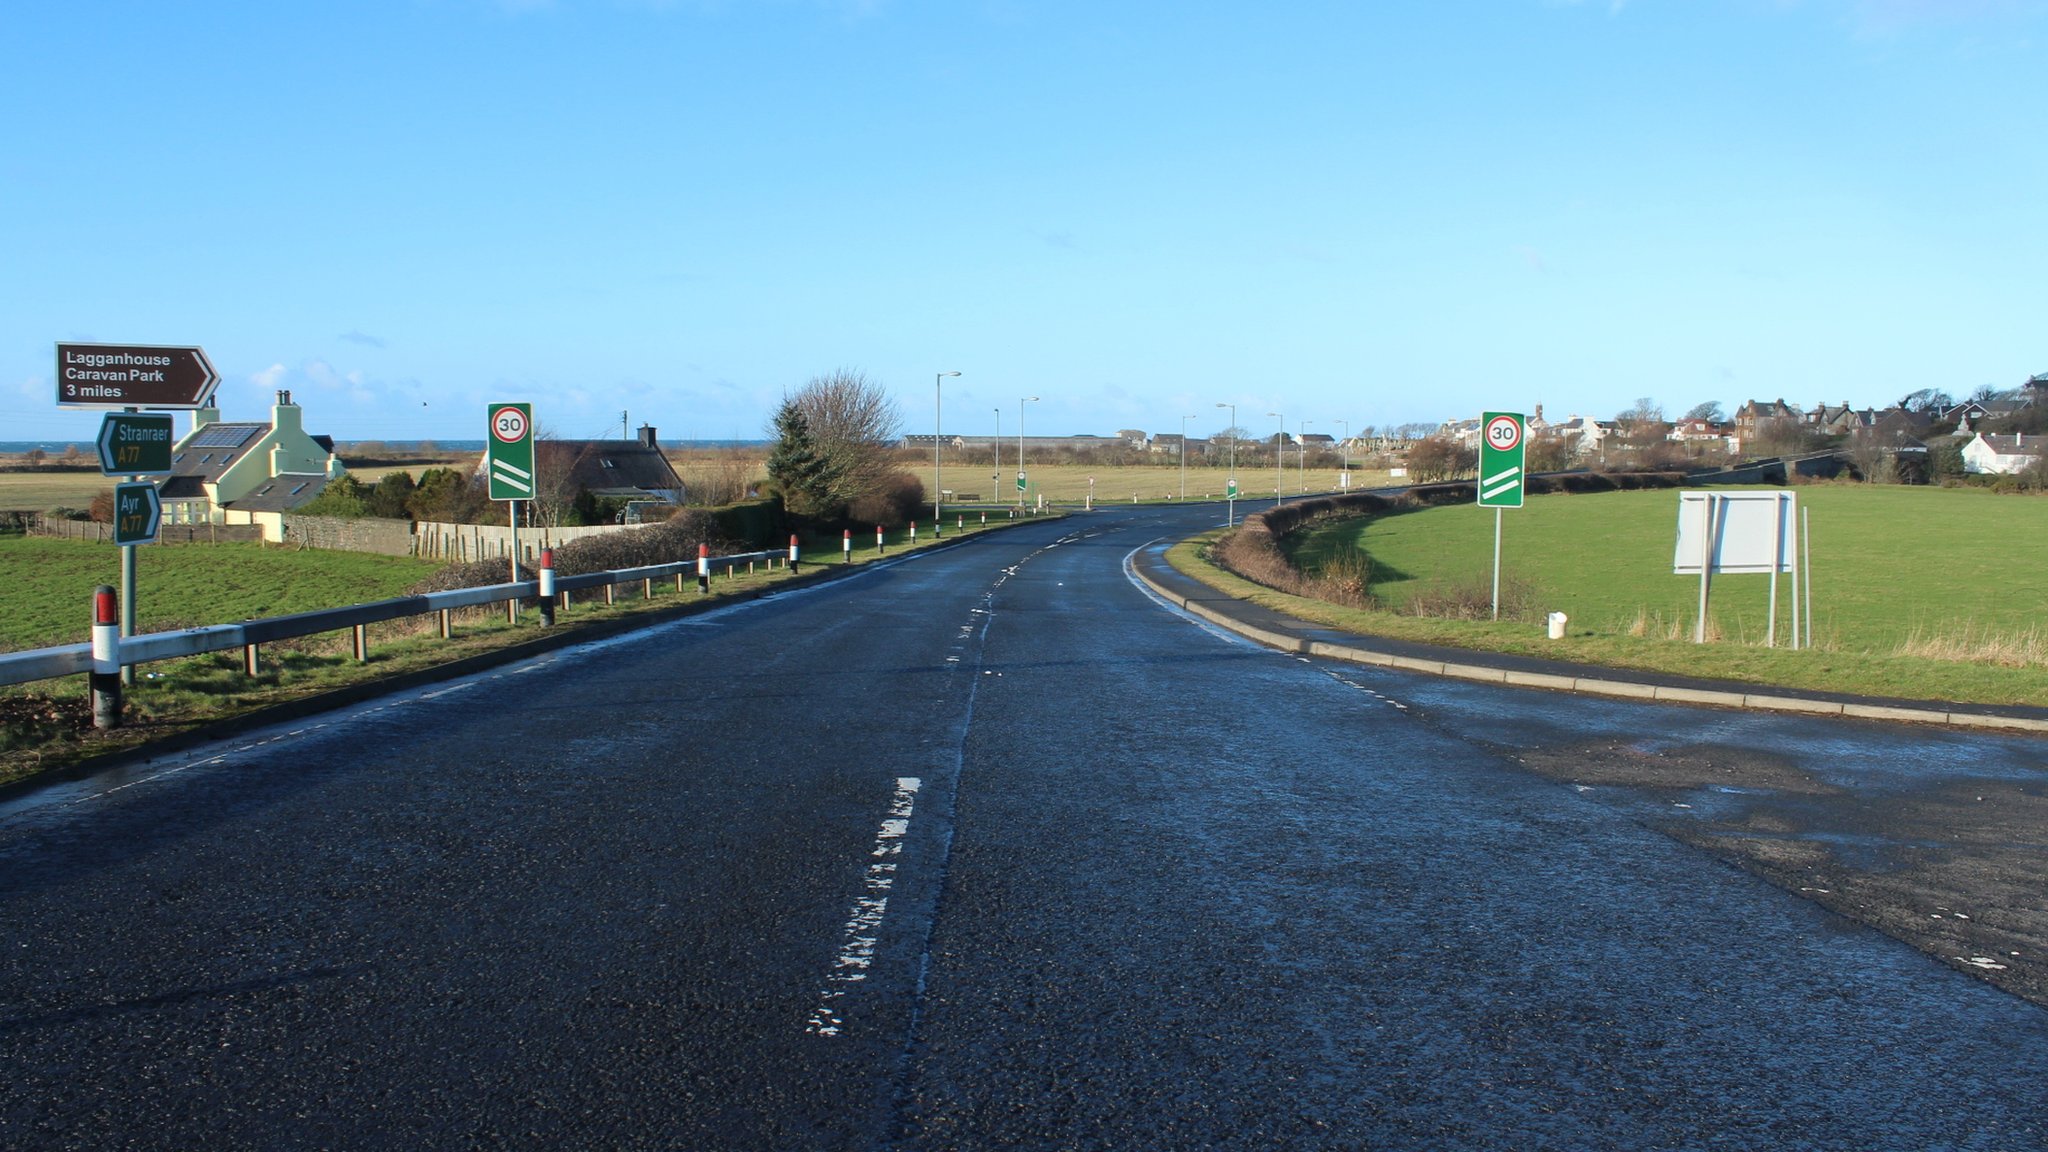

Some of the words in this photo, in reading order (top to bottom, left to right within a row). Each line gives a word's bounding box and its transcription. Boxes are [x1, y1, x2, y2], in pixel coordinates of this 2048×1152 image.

[66, 351, 171, 367] Lagganhouse
[65, 367, 127, 382] Caravan
[130, 369, 164, 382] Park
[66, 384, 76, 397] 3
[80, 385, 122, 397] miles
[119, 424, 169, 441] Stranraer
[499, 418, 521, 431] 30
[1492, 427, 1514, 440] 30
[118, 446, 140, 463] A77
[121, 494, 140, 514] Ayr
[121, 515, 142, 533] A77
